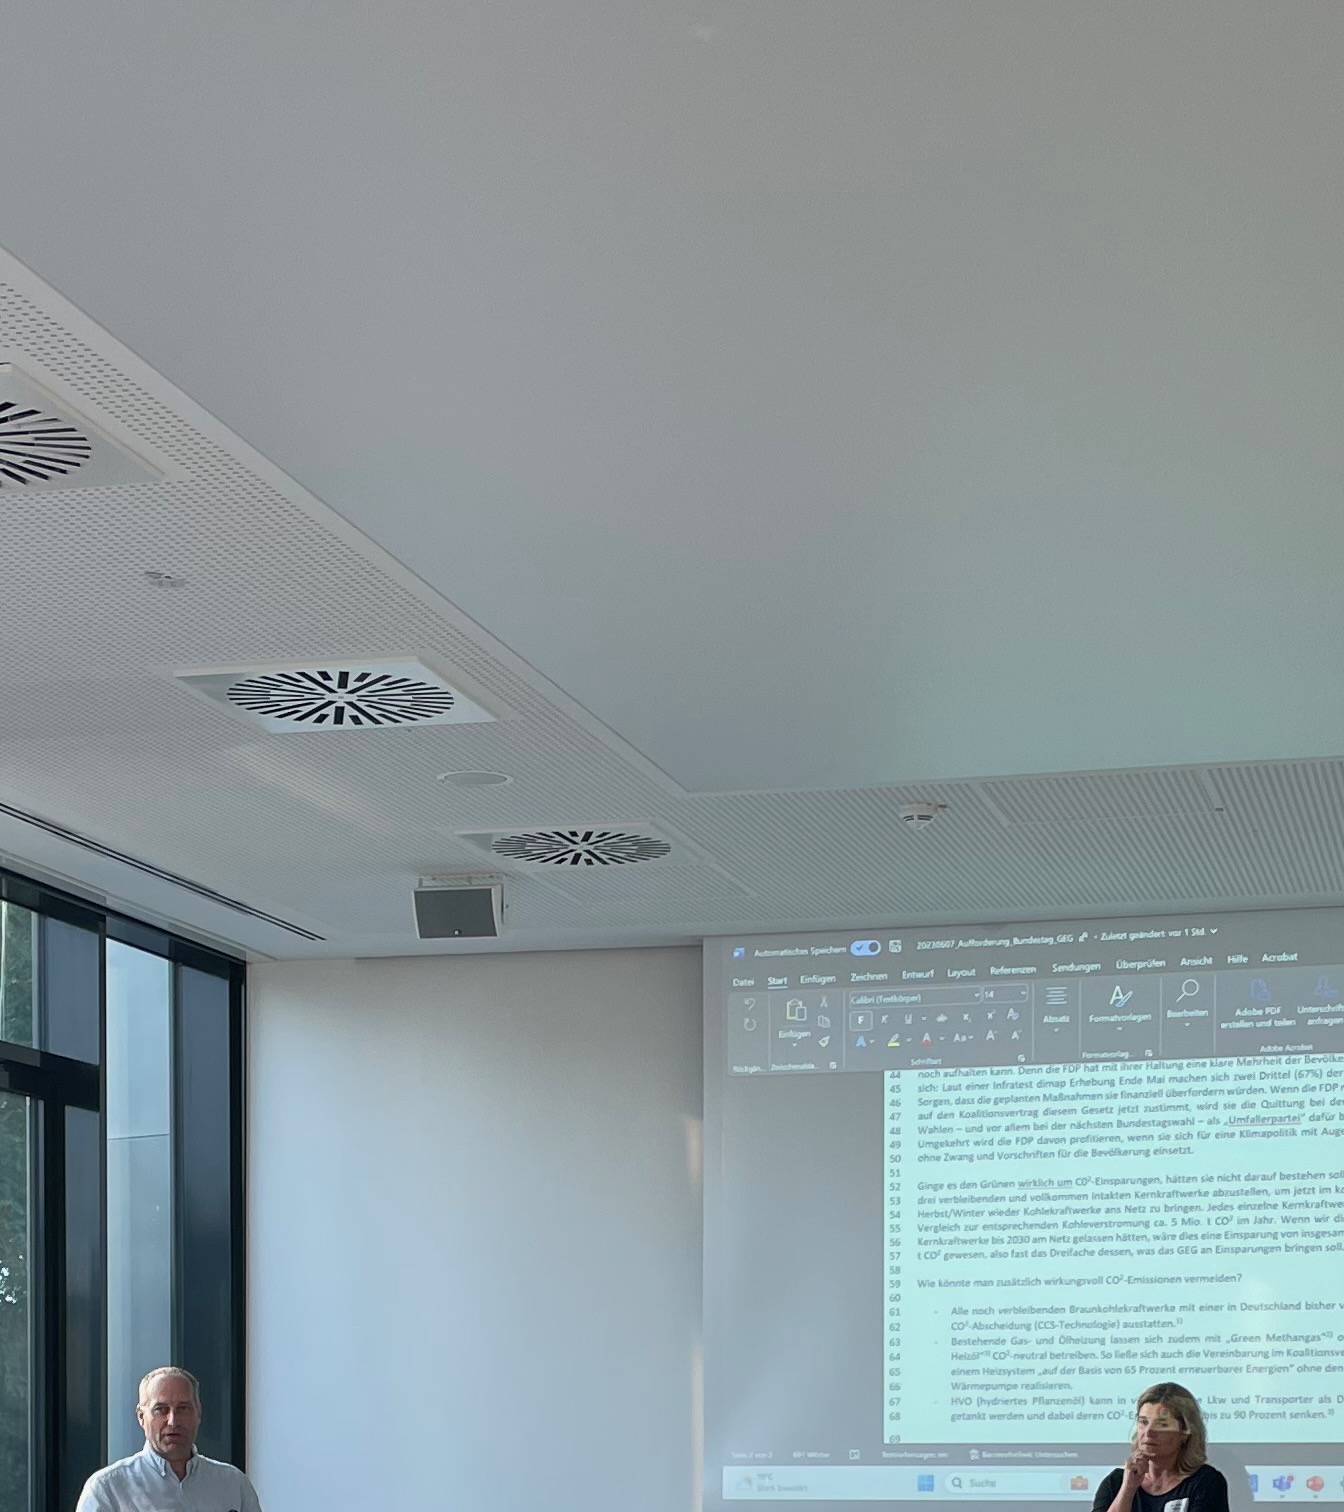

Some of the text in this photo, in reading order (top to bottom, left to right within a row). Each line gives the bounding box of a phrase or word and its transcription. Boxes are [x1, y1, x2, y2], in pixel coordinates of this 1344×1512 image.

[732, 977, 754, 987] Datei
[768, 976, 788, 986] Start
[800, 974, 836, 986] Einfügen
[850, 972, 888, 982] Zeichnen
[902, 969, 934, 980] Entwurf
[948, 968, 976, 980] Layout
[1052, 962, 1101, 974] Sendungen
[1116, 958, 1166, 970] Überprüfen
[1180, 956, 1214, 966] Ansicht
[1262, 952, 1298, 962] Acrobat
[918, 1082, 939, 1092] sich:
[942, 1081, 963, 1091] Laut
[965, 1080, 990, 1091] einer
[993, 1079, 1034, 1090] Infratest
[1069, 1077, 1116, 1089] Erhebung
[1119, 1076, 1143, 1086] Ende
[1147, 1075, 1166, 1085] Mai
[1168, 1074, 1208, 1084] machen
[1211, 1073, 1230, 1083] sich
[1233, 1072, 1256, 1082] zwei
[1259, 1071, 1291, 1082] Drittel
[1326, 1069, 1344, 1080] der
[918, 1110, 933, 1120] auf
[936, 1110, 955, 1119] den
[959, 1107, 1039, 1121] Koalitionsvertrag
[1042, 1106, 1077, 1116] diesem
[1081, 1105, 1114, 1115] Gesetz
[1117, 1104, 1139, 1116] jetzt
[1196, 1102, 1219, 1112] wird
[1223, 1101, 1237, 1111] sie
[1241, 1101, 1257, 1111] die
[1260, 1099, 1306, 1112] Quittung
[1309, 1099, 1326, 1109] bei
[918, 1137, 970, 1150] Umgekehrt
[973, 1137, 994, 1147] wird
[997, 1136, 1012, 1146] die
[1015, 1136, 1034, 1145] FDP
[1037, 1135, 1067, 1145] davon
[1157, 1132, 1171, 1142] sie
[1174, 1131, 1194, 1141] sich
[1197, 1131, 1211, 1141] für
[1215, 1130, 1236, 1140] eine
[1239, 1128, 1298, 1142] Klimapolitik
[1301, 1128, 1318, 1138] mit
[917, 1195, 936, 1204] drei
[938, 1193, 1006, 1204] verbleibenden
[1009, 1193, 1028, 1202] und
[1030, 1191, 1089, 1202] vollkommen
[1091, 1190, 1132, 1201] intakten
[1134, 1189, 1210, 1200] Kernkraftwerke
[1293, 1186, 1316, 1198] jetzt
[1319, 1186, 1332, 1196] im
[917, 1222, 961, 1234] Vergleich
[982, 1220, 1059, 1233] entsprechenden
[1062, 1218, 1150, 1231] Kohleverstromung
[1237, 1216, 1250, 1226] im
[1280, 1215, 1311, 1225] Wenn
[1313, 1215, 1330, 1224] wir
[917, 1278, 936, 1288] Wie
[938, 1278, 971, 1287] könnte
[996, 1277, 1042, 1287] zusätzlich
[1044, 1276, 1104, 1288] wirkungsvoll
[1184, 1273, 1243, 1284] vermeiden?
[951, 1306, 969, 1316] Alle
[972, 1306, 995, 1315] noch
[998, 1305, 1066, 1315] verbleibenden
[1069, 1303, 1176, 1314] Braunkohlekraftwerke
[1179, 1303, 1195, 1313] mit
[1199, 1303, 1224, 1312] einer
[1240, 1302, 1302, 1312] Deutschland
[1305, 1301, 1337, 1311] bisher
[951, 1336, 1007, 1346] Bestehende
[1010, 1336, 1032, 1345] Gas-
[1035, 1336, 1055, 1345] und
[1110, 1335, 1140, 1344] lassen
[1144, 1334, 1163, 1344] sich
[1168, 1334, 1201, 1344] zudem
[1205, 1334, 1222, 1343] mit
